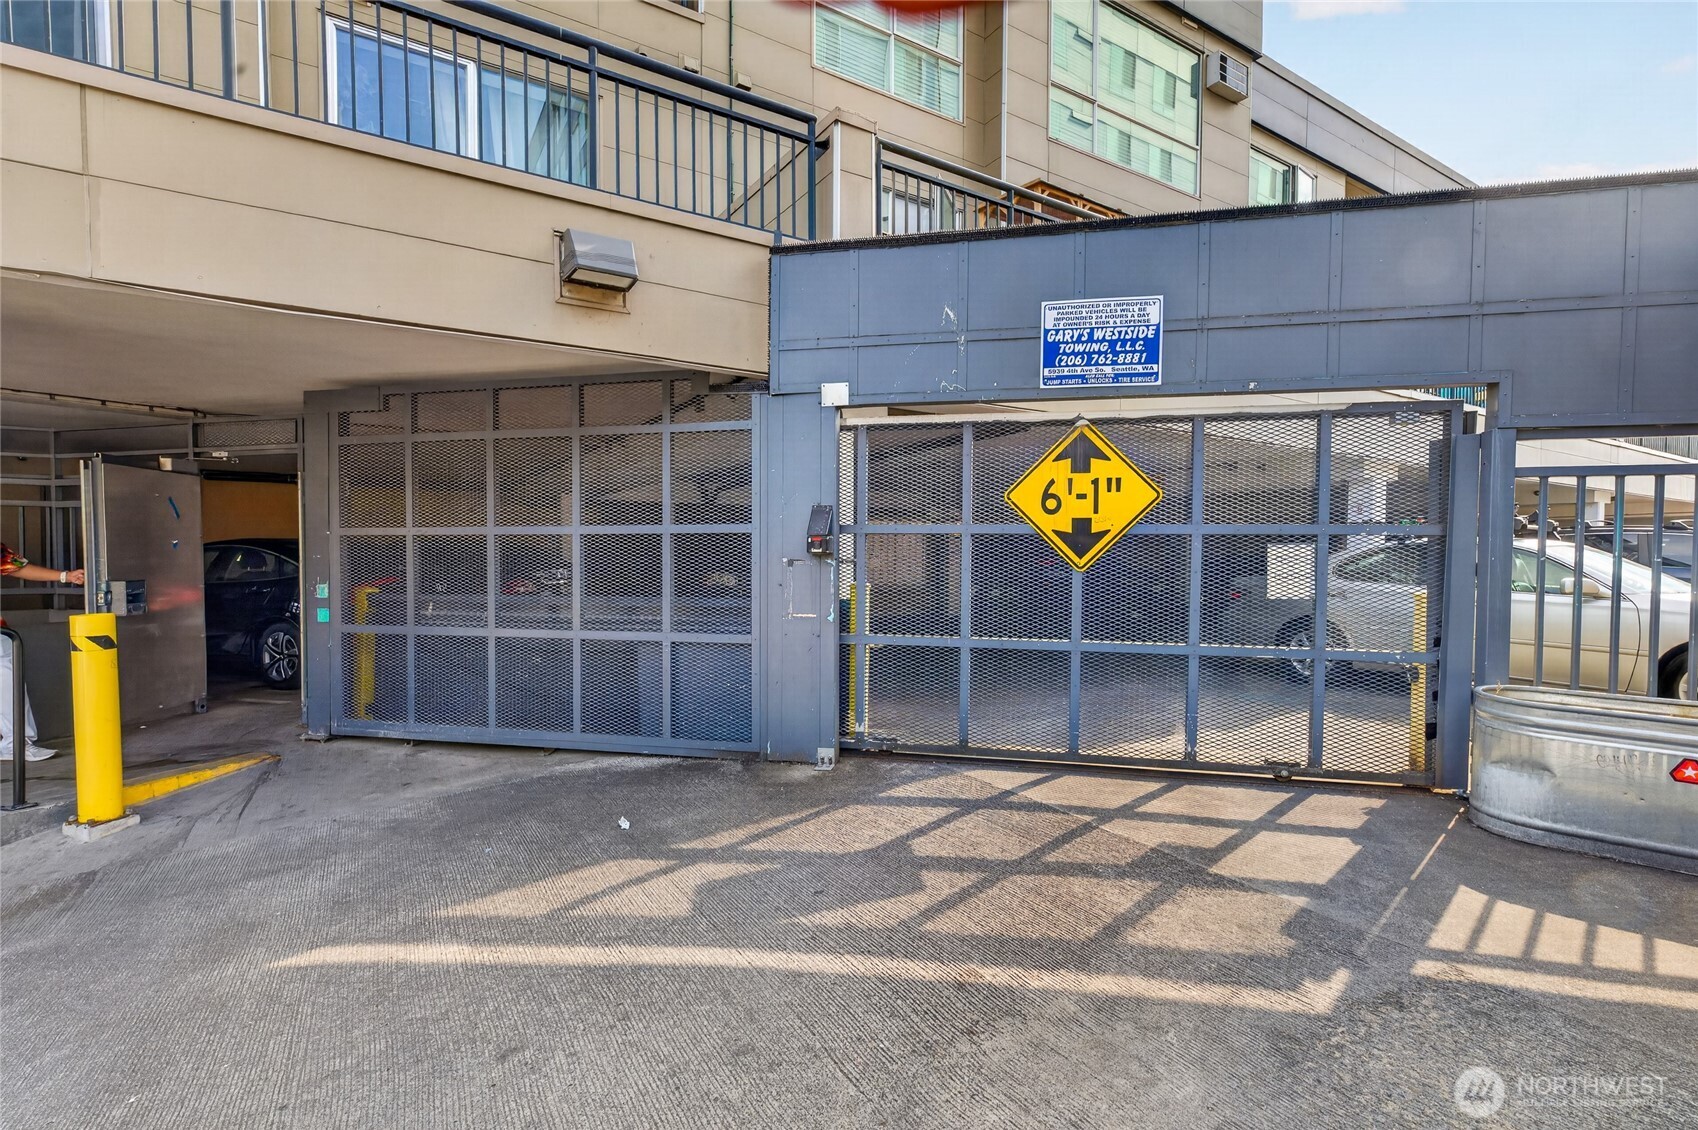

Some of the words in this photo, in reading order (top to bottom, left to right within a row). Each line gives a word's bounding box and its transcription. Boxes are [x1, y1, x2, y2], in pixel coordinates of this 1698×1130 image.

[1047, 328, 1090, 342] GARY'S
[1093, 326, 1157, 340] WESTSIDE
[1059, 343, 1111, 353] TOWING,
[1116, 341, 1145, 351] L.L.C.
[1055, 354, 1088, 366] (206)
[1091, 352, 1147, 364] 762-8881
[1040, 478, 1122, 515] 6'-1"
